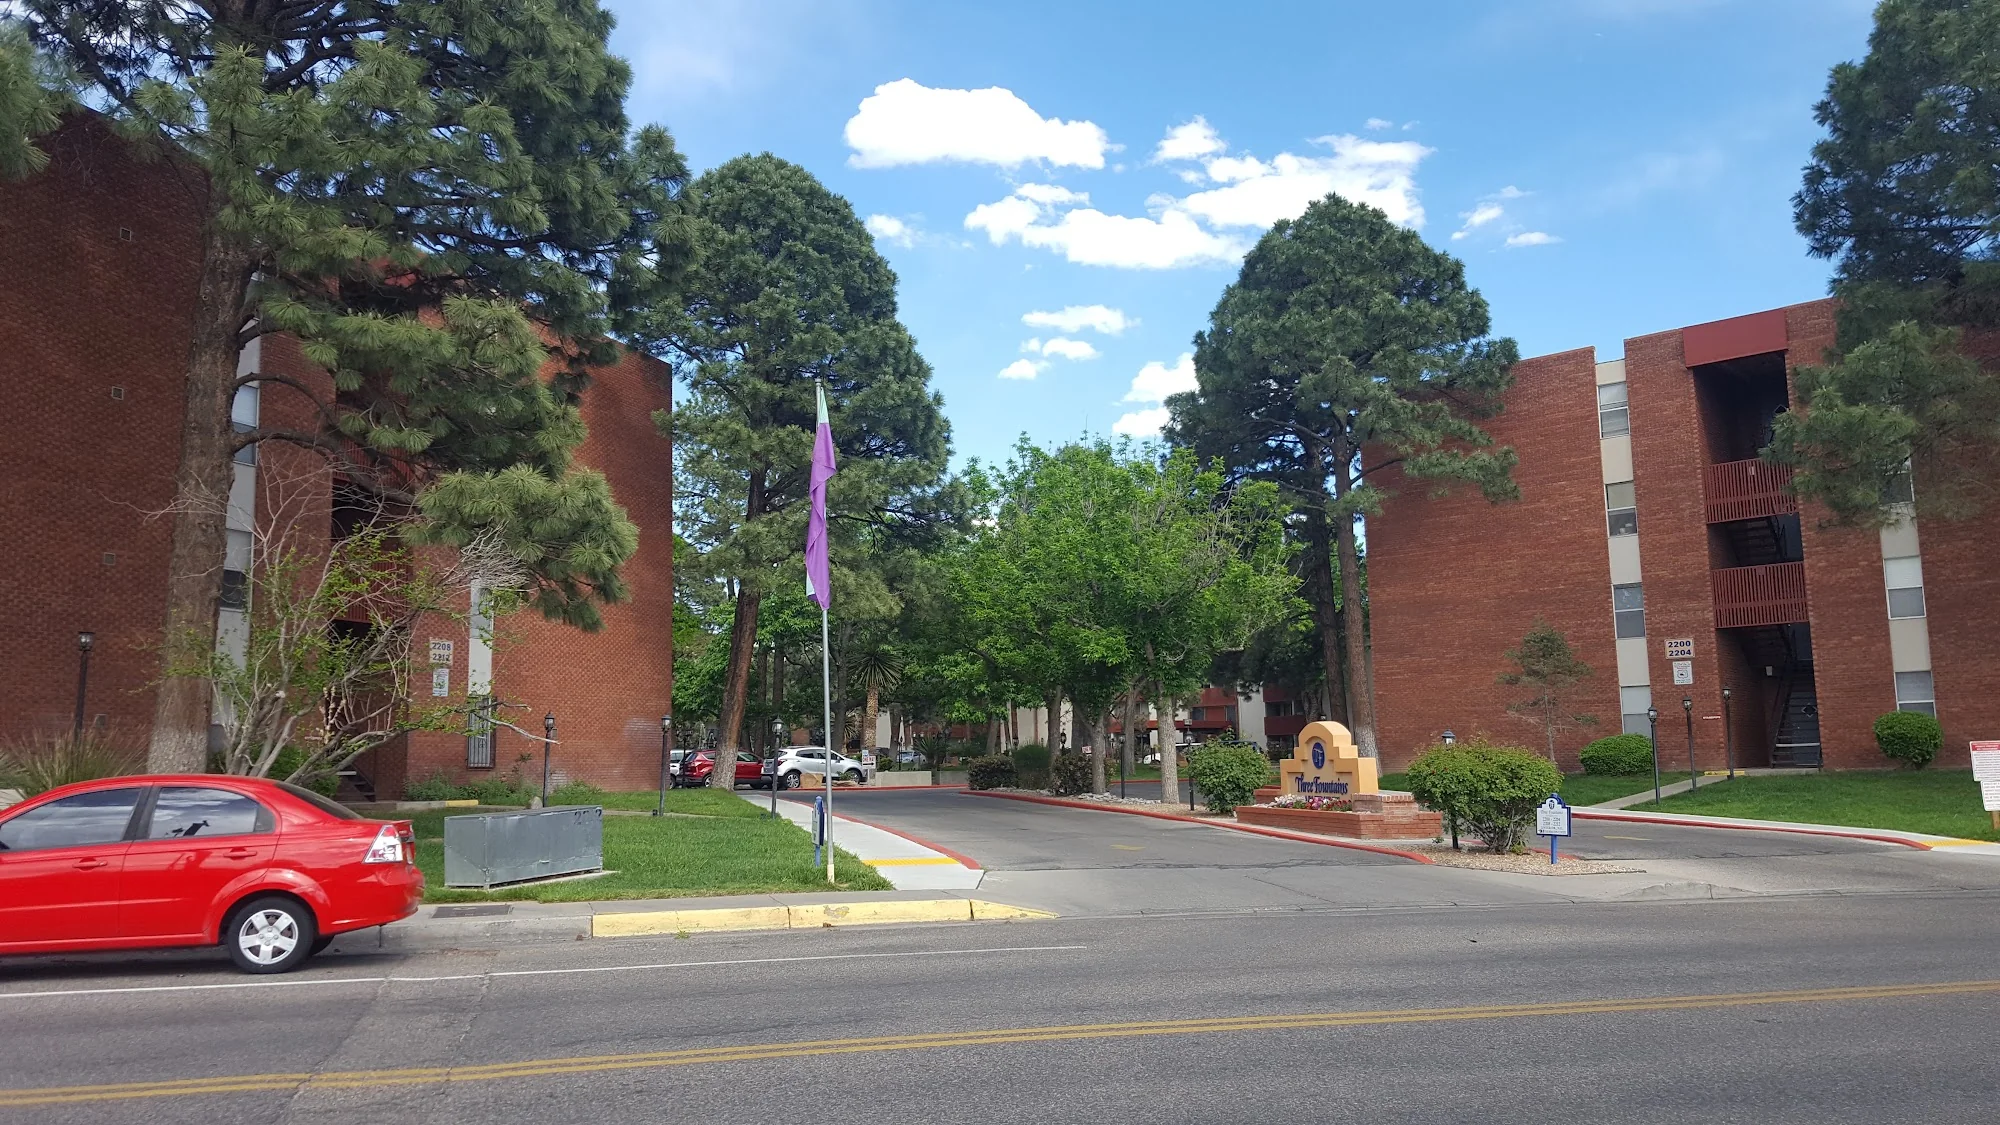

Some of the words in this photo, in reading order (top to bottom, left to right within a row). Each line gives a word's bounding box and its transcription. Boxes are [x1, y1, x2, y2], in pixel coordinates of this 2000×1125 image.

[432, 642, 451, 651] 2208
[1295, 773, 1314, 793] Three
[1313, 776, 1348, 795] Fountains
